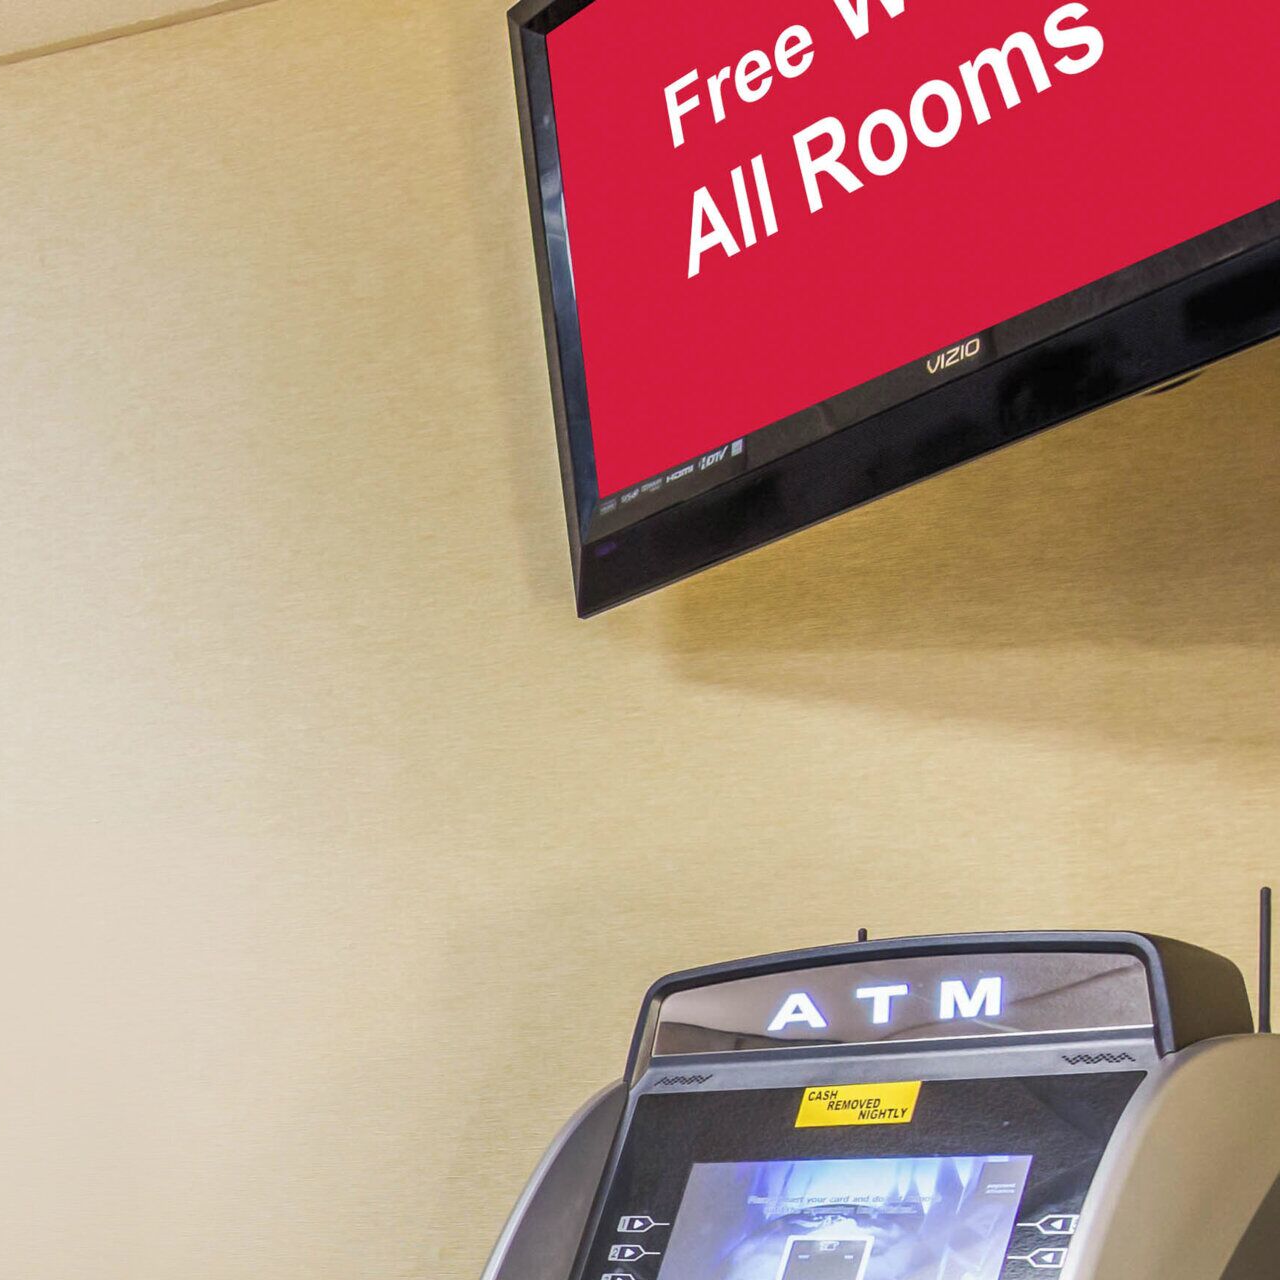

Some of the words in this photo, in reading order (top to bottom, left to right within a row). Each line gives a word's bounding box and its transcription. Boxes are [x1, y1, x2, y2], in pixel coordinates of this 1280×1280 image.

[663, 24, 815, 149] Free
[687, 153, 779, 280] All
[792, 1, 1106, 214] Rooms
[927, 338, 980, 374] VIZIO
[767, 975, 1005, 1032] ATM
[808, 1090, 838, 1101] CASH
[827, 1098, 881, 1111] REMOVED
[858, 1108, 908, 1120] NIGHTLY
